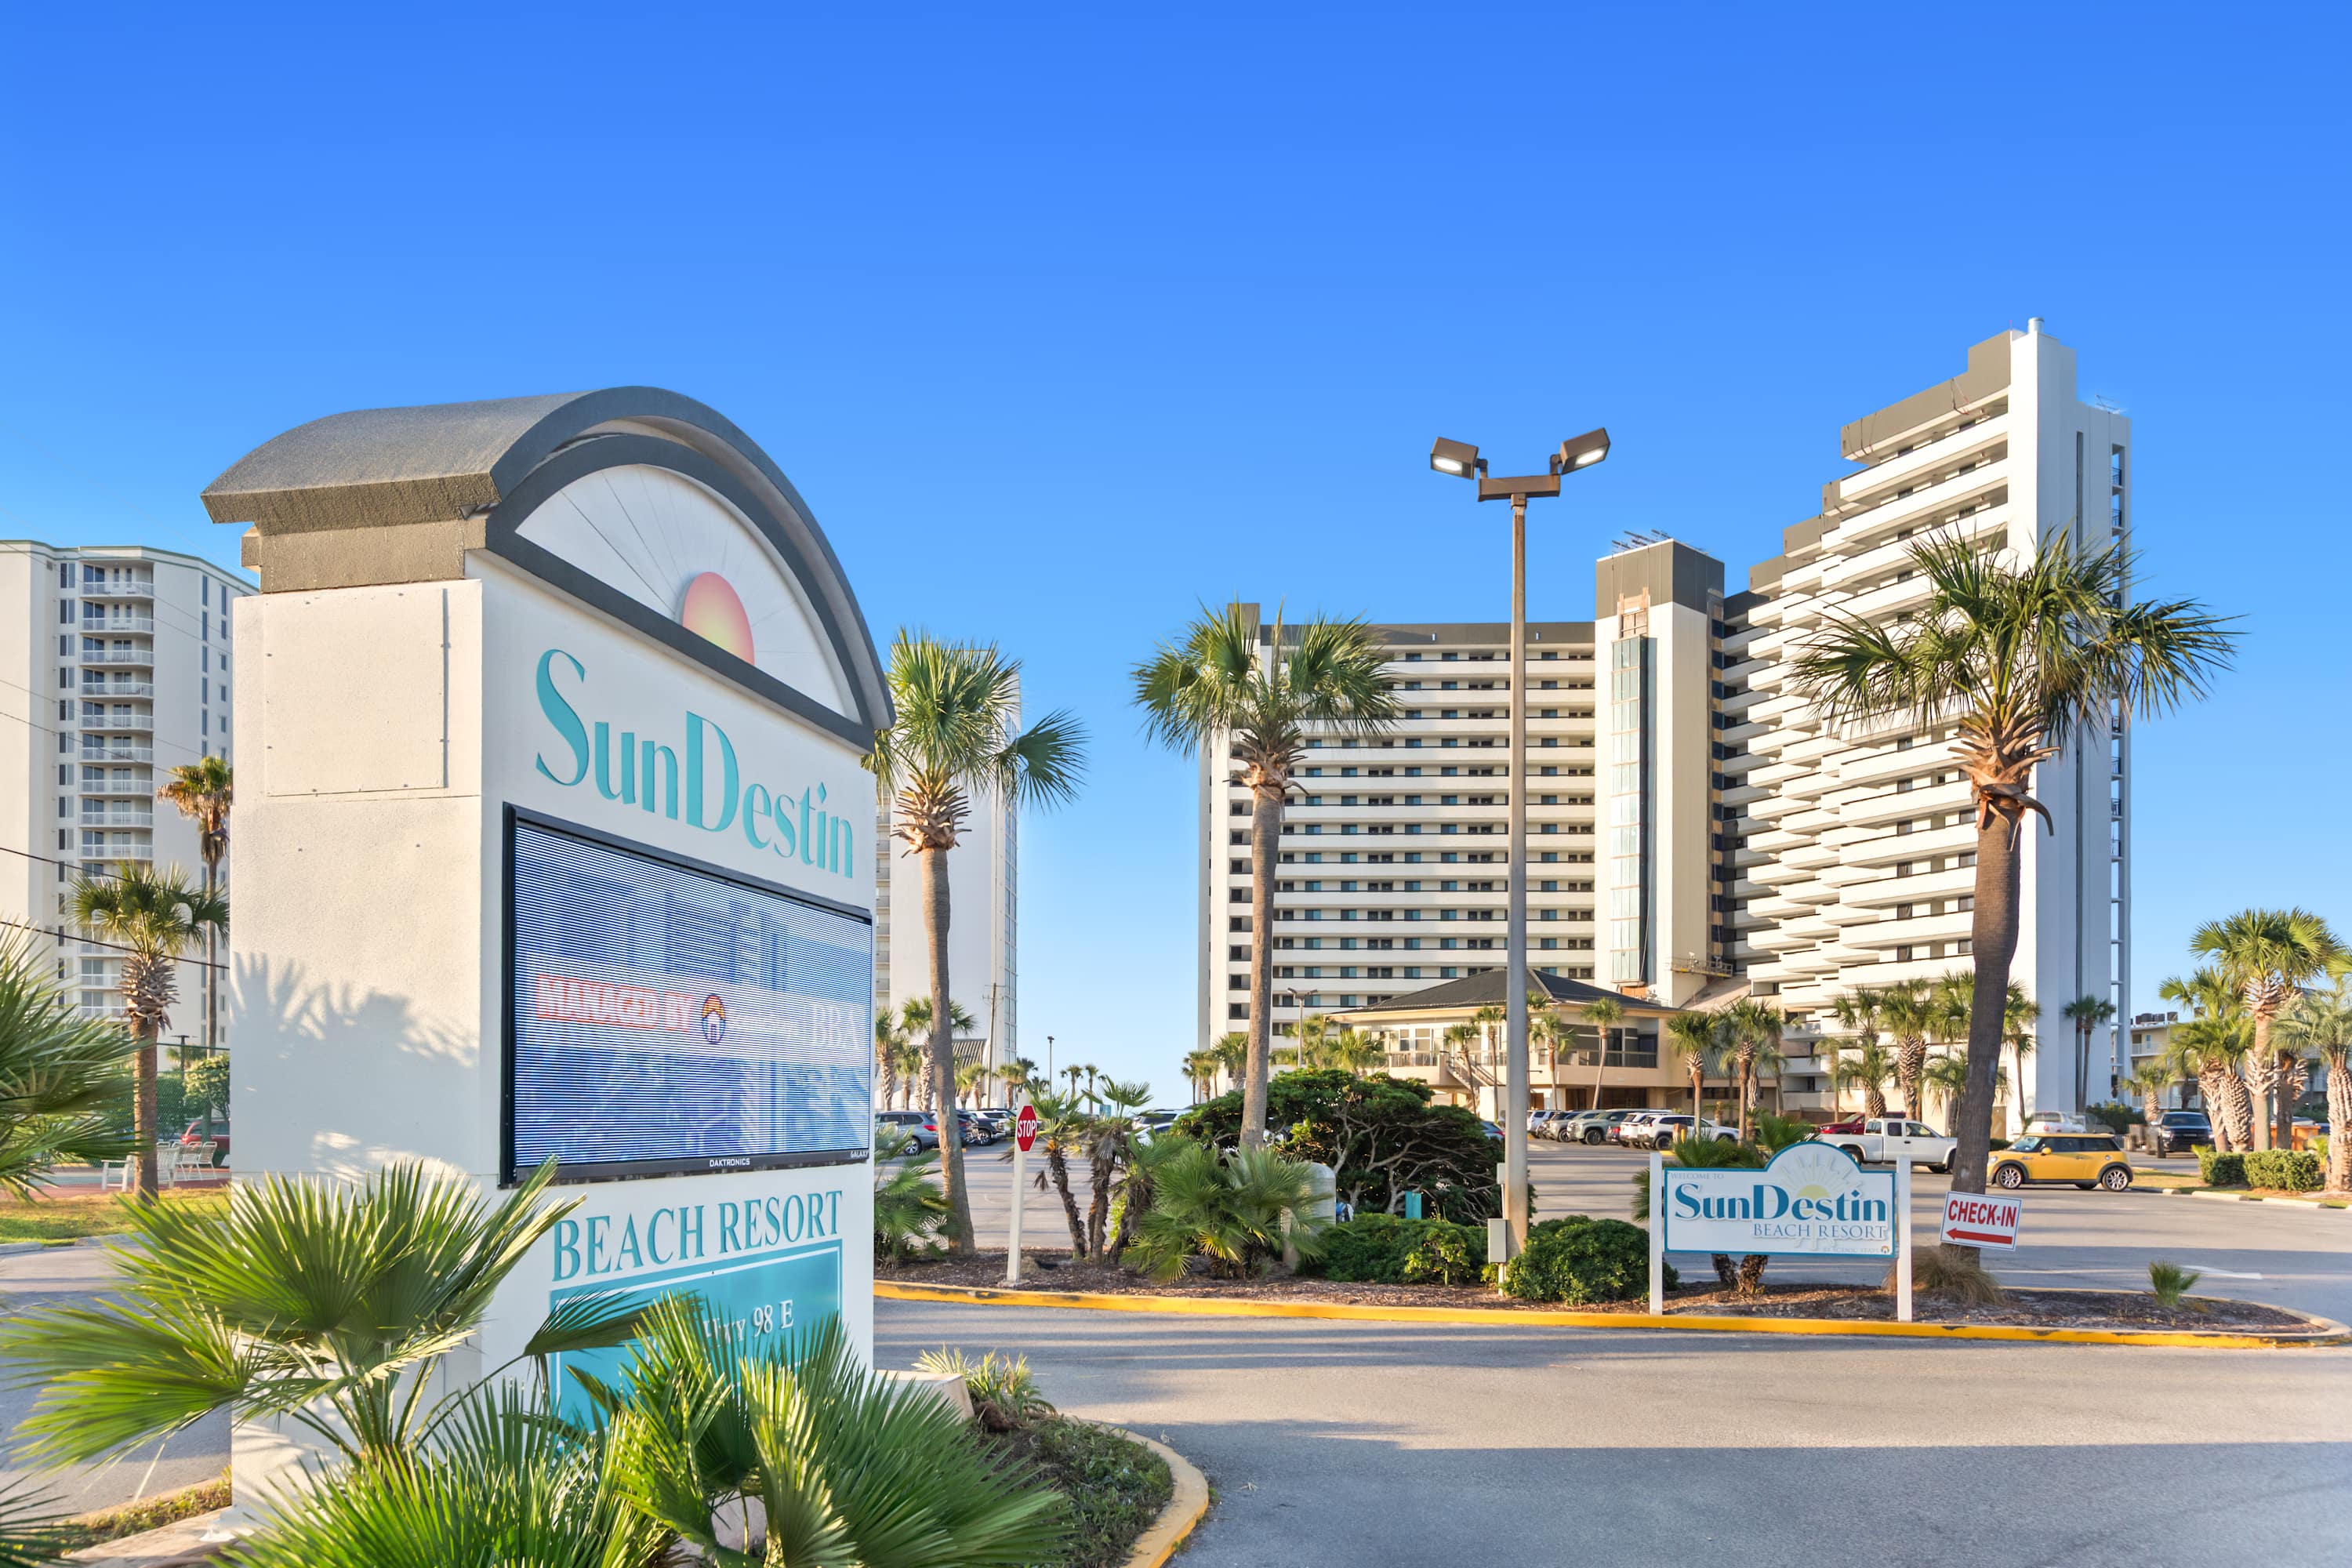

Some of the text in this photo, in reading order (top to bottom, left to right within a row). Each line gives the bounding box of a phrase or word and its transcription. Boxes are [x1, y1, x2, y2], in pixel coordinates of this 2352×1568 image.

[535, 648, 853, 879] SunDestin
[536, 973, 695, 1033] MANAGED BY
[1018, 1120, 1036, 1137] STOP
[710, 1158, 750, 1167] DAKTRONICS
[1675, 1184, 1886, 1221] SunDestin
[1949, 1200, 2016, 1227] CHECK-IN
[552, 1190, 843, 1282] BEACH RESORT
[1753, 1224, 1886, 1239] BEACH RESORT
[753, 1305, 773, 1338] 98
[779, 1299, 794, 1329] E
